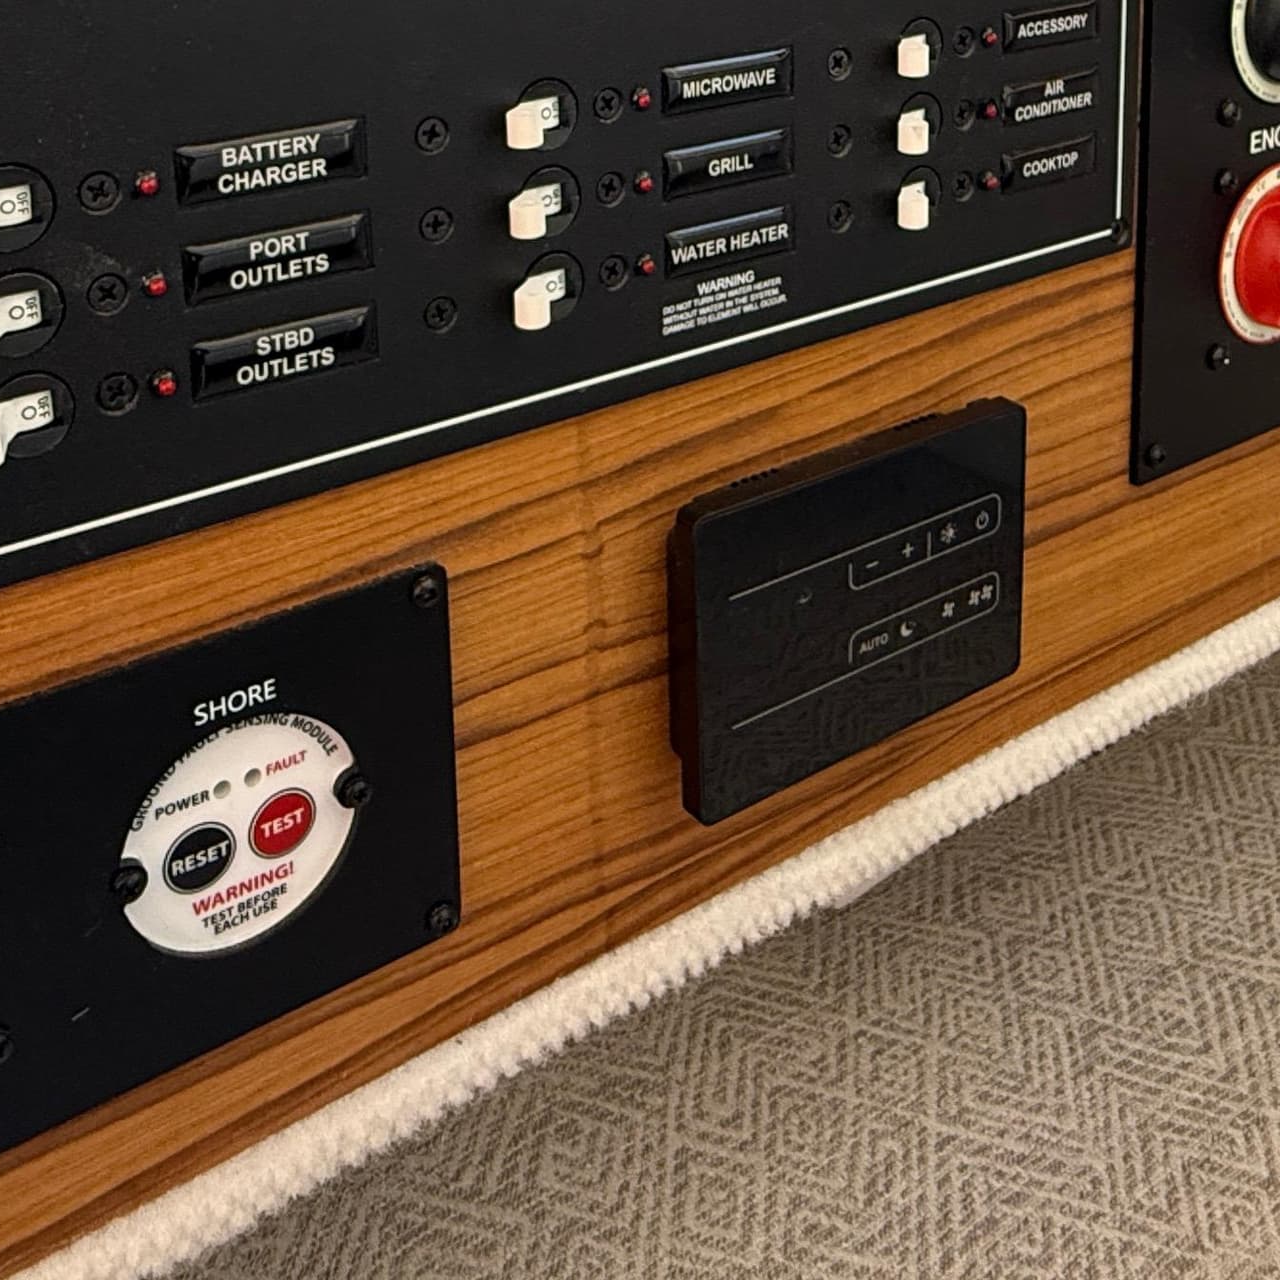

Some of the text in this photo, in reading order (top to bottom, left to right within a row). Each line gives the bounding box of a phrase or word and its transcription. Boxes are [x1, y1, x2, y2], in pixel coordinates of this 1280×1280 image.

[1018, 13, 1088, 40] ACCESSORY
[683, 68, 776, 99] MICROWAVE
[1044, 79, 1064, 98] AIR
[1015, 92, 1092, 122] CONDITIONER
[221, 134, 321, 168] BATTERY
[708, 154, 754, 177] GRILL
[1023, 151, 1078, 178] COOKTOP
[218, 158, 327, 194] CHARGER
[16, 191, 29, 215] OFF
[249, 232, 309, 260] PORT
[671, 224, 788, 265] WATER HEATER
[230, 253, 330, 290] OUTLETS
[697, 270, 755, 296] WARNING
[25, 295, 40, 320] OFF
[256, 327, 315, 357] STBD
[236, 347, 336, 386] OUTLETS
[37, 395, 52, 420] OFF
[860, 633, 889, 654] AUTO
[193, 678, 277, 727] SHORE
[291, 716, 339, 757] MODULE
[266, 749, 308, 777] FAULT
[154, 789, 210, 821] POWER
[260, 807, 306, 839] TEST
[170, 839, 231, 877] RESET
[192, 860, 294, 916] WARNING!
[201, 882, 288, 928] TEST BEFORE
[213, 897, 279, 936] EACH USE
